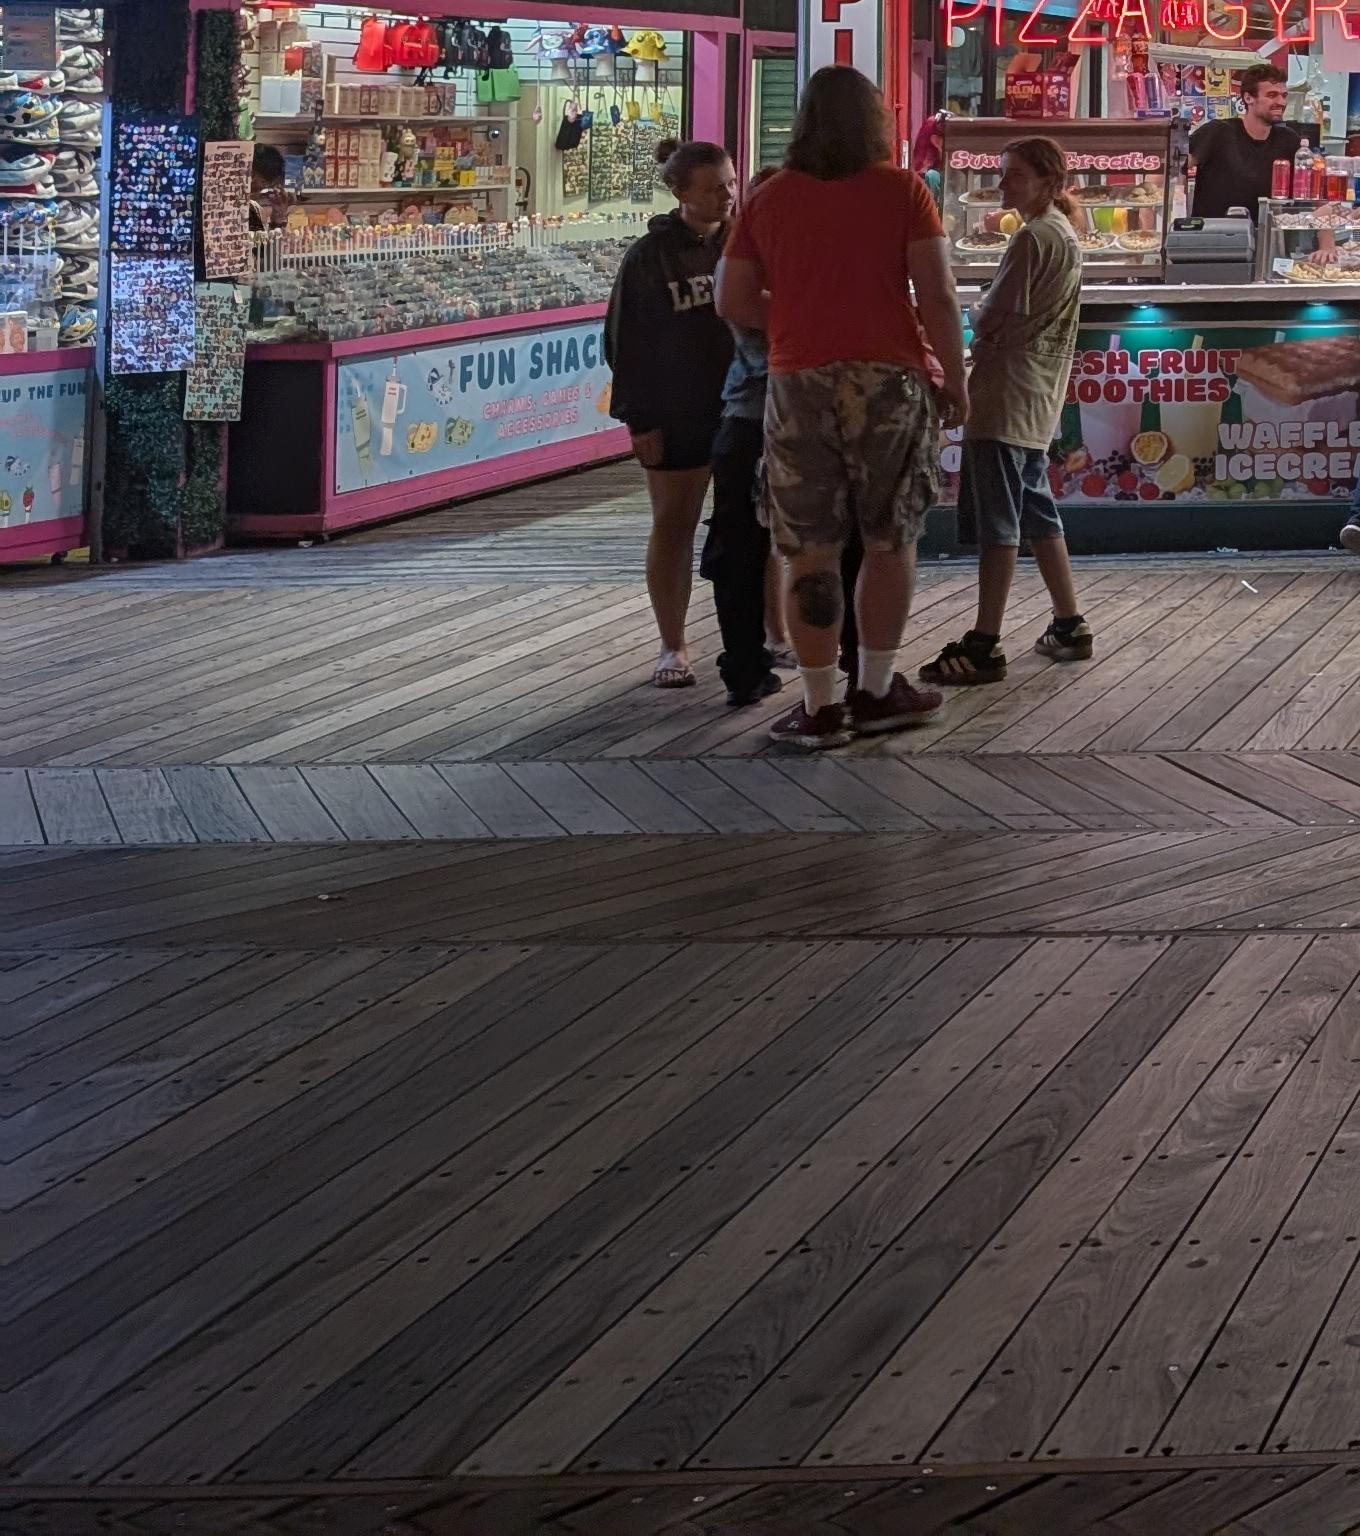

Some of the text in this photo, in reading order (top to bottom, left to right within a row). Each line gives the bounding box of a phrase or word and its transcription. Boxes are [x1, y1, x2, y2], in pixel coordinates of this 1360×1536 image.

[667, 274, 714, 313] LE
[459, 332, 608, 394] FUN SHAC
[1073, 348, 1243, 376] ESH FRUIT
[28, 385, 54, 401] THE
[1066, 377, 1231, 404] OOTHIES
[498, 406, 579, 439] ACCESSORIES
